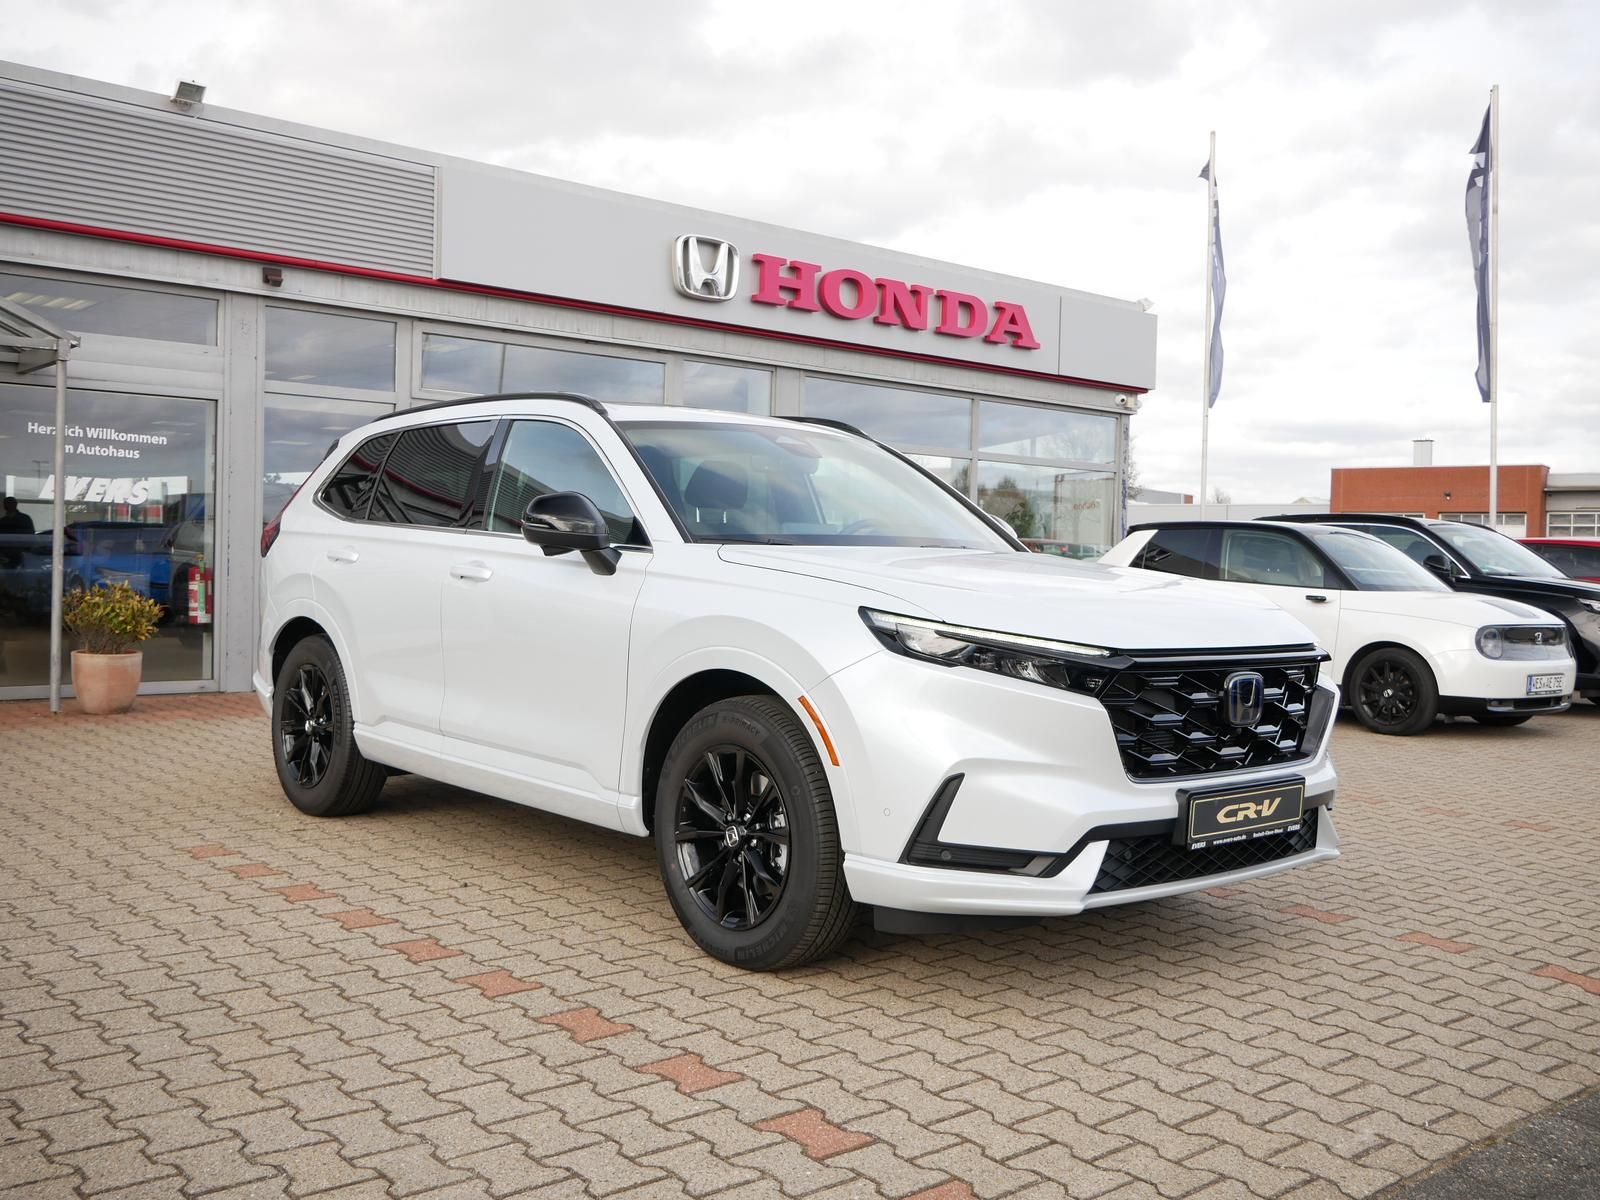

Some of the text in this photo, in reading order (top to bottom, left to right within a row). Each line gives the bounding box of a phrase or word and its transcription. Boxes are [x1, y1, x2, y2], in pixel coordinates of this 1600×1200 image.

[750, 253, 1041, 350] HONDA
[27, 422, 168, 445] Herzich Willkommen
[76, 444, 140, 459] Autohaus
[1216, 797, 1282, 824] CR-V
